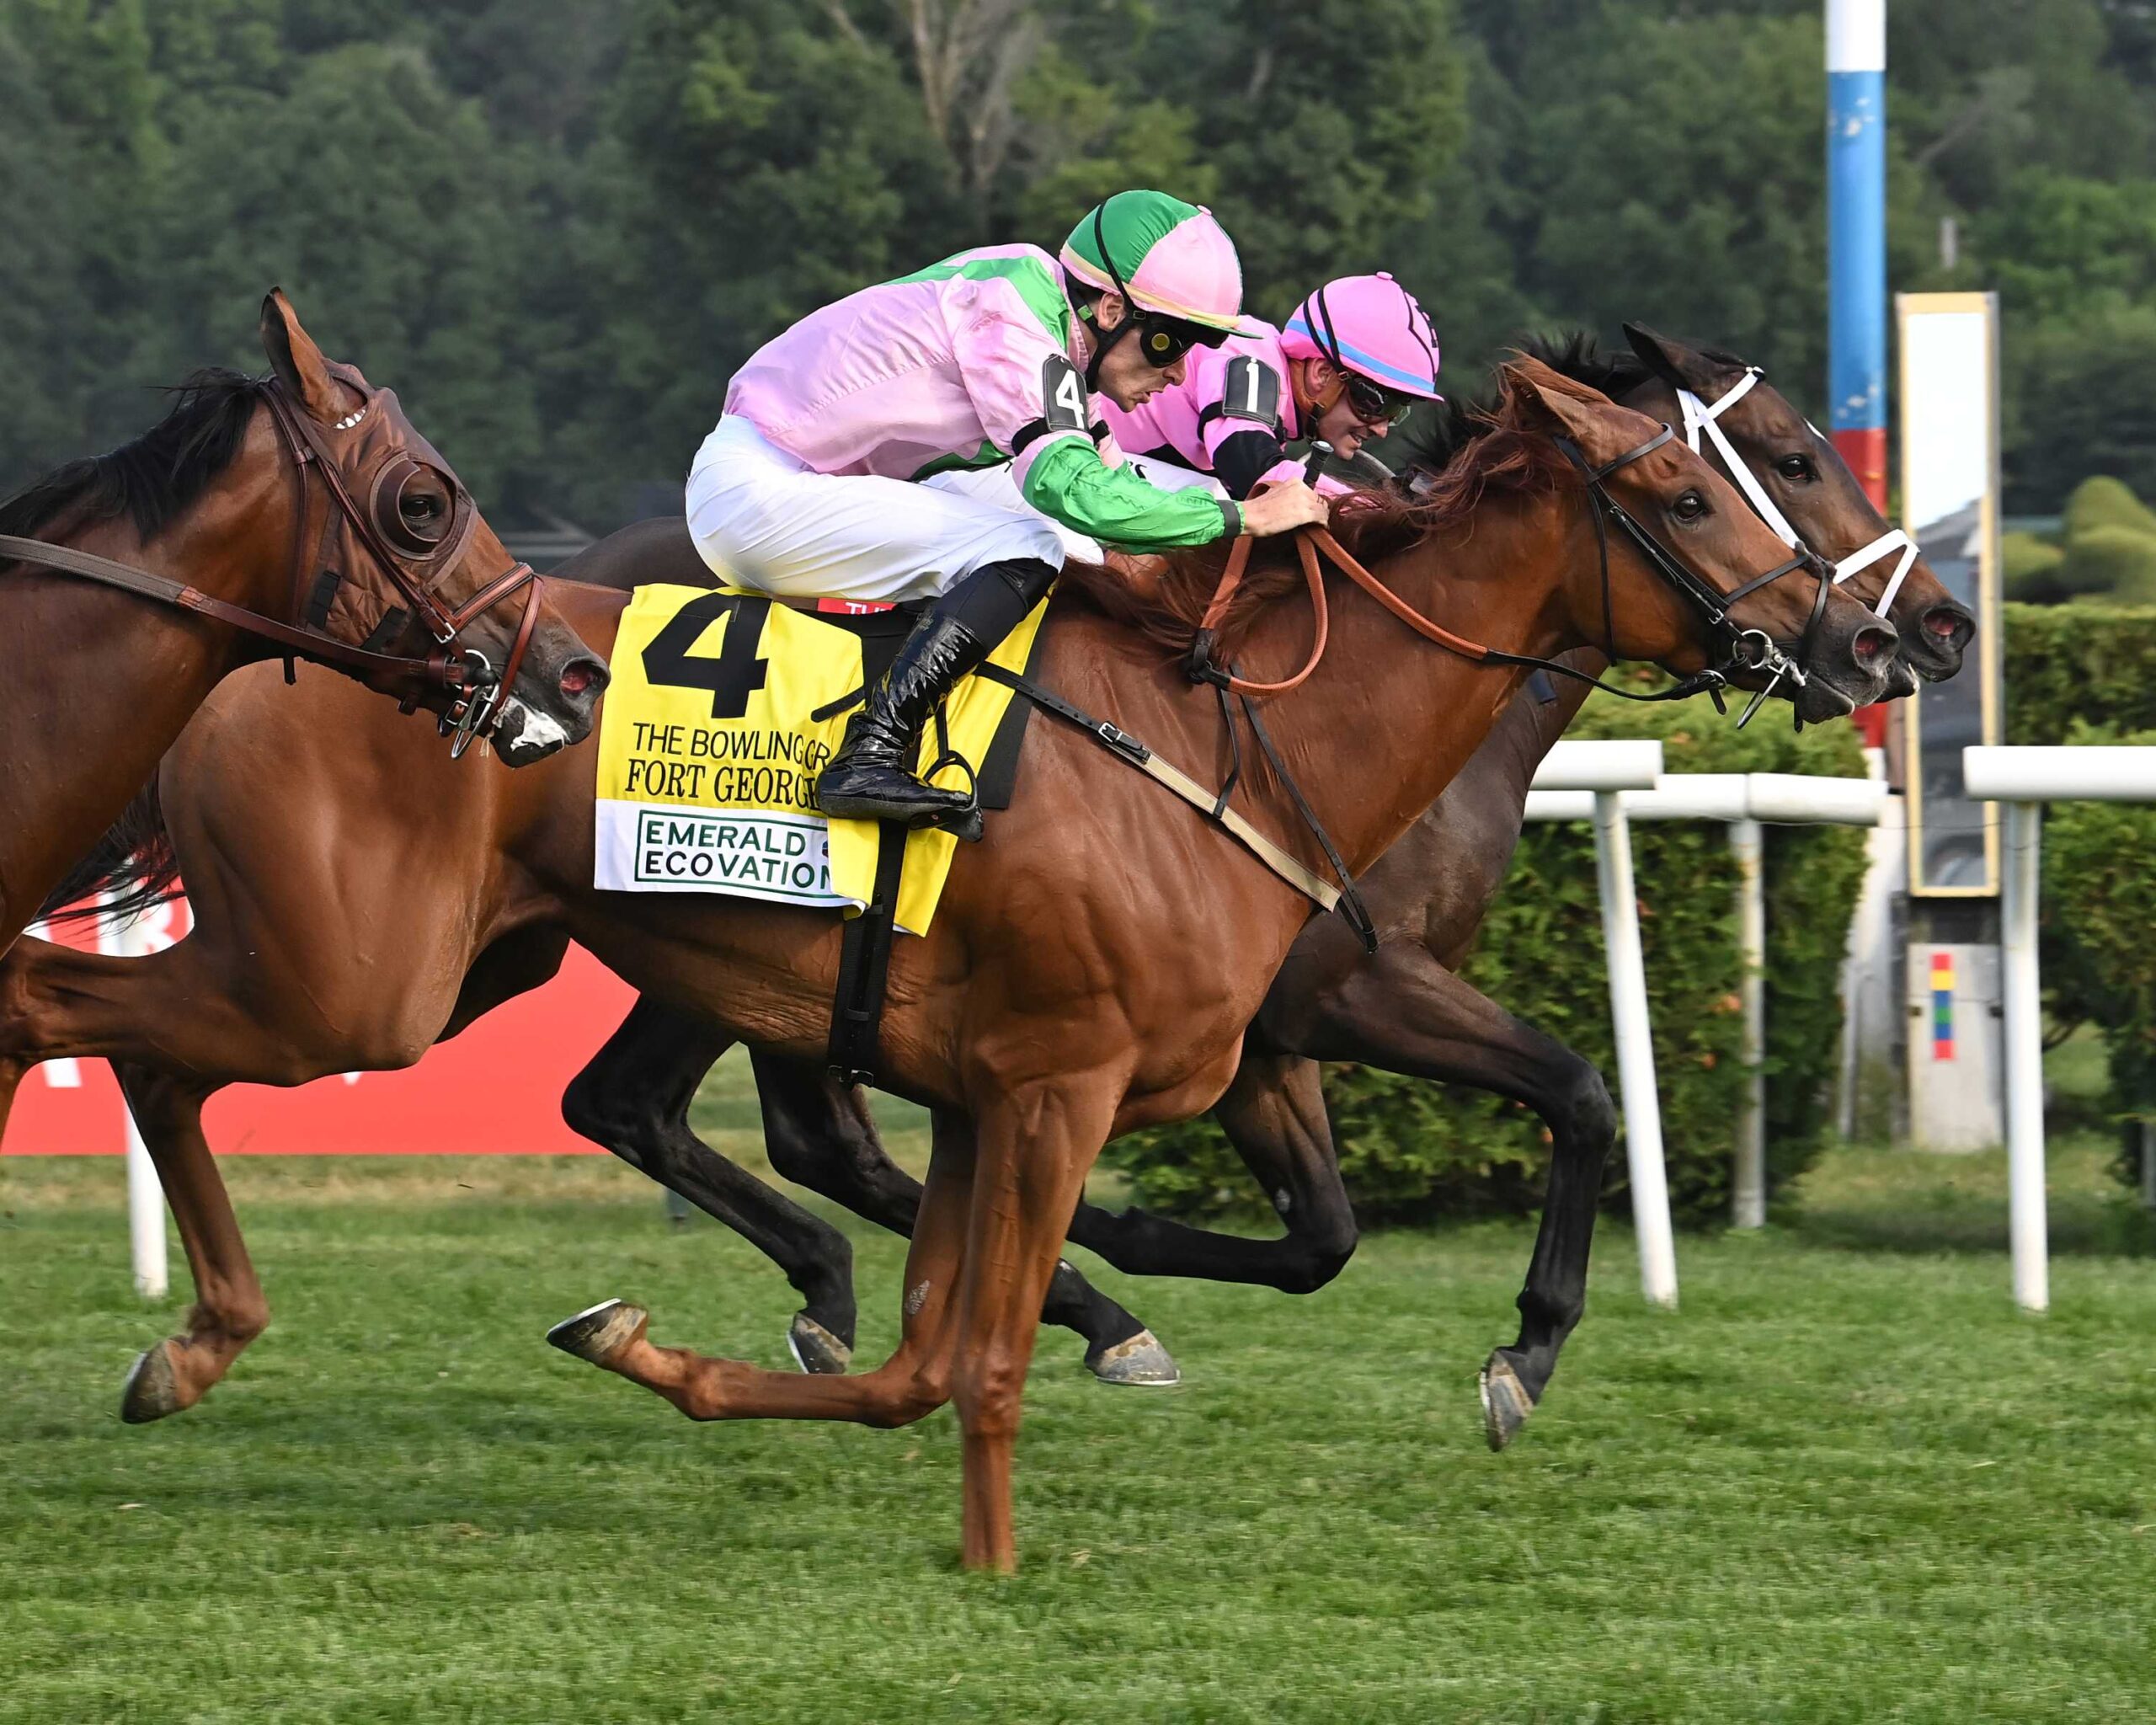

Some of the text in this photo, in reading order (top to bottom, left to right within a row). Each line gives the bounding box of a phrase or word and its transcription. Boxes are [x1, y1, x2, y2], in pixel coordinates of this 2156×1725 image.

[1055, 369, 1085, 430] 4
[1246, 361, 1259, 413] 1
[641, 591, 773, 719] 4
[632, 722, 686, 755] THE
[690, 728, 804, 765] BOWLING
[625, 758, 707, 798] FORT
[645, 820, 806, 857] EMERALD
